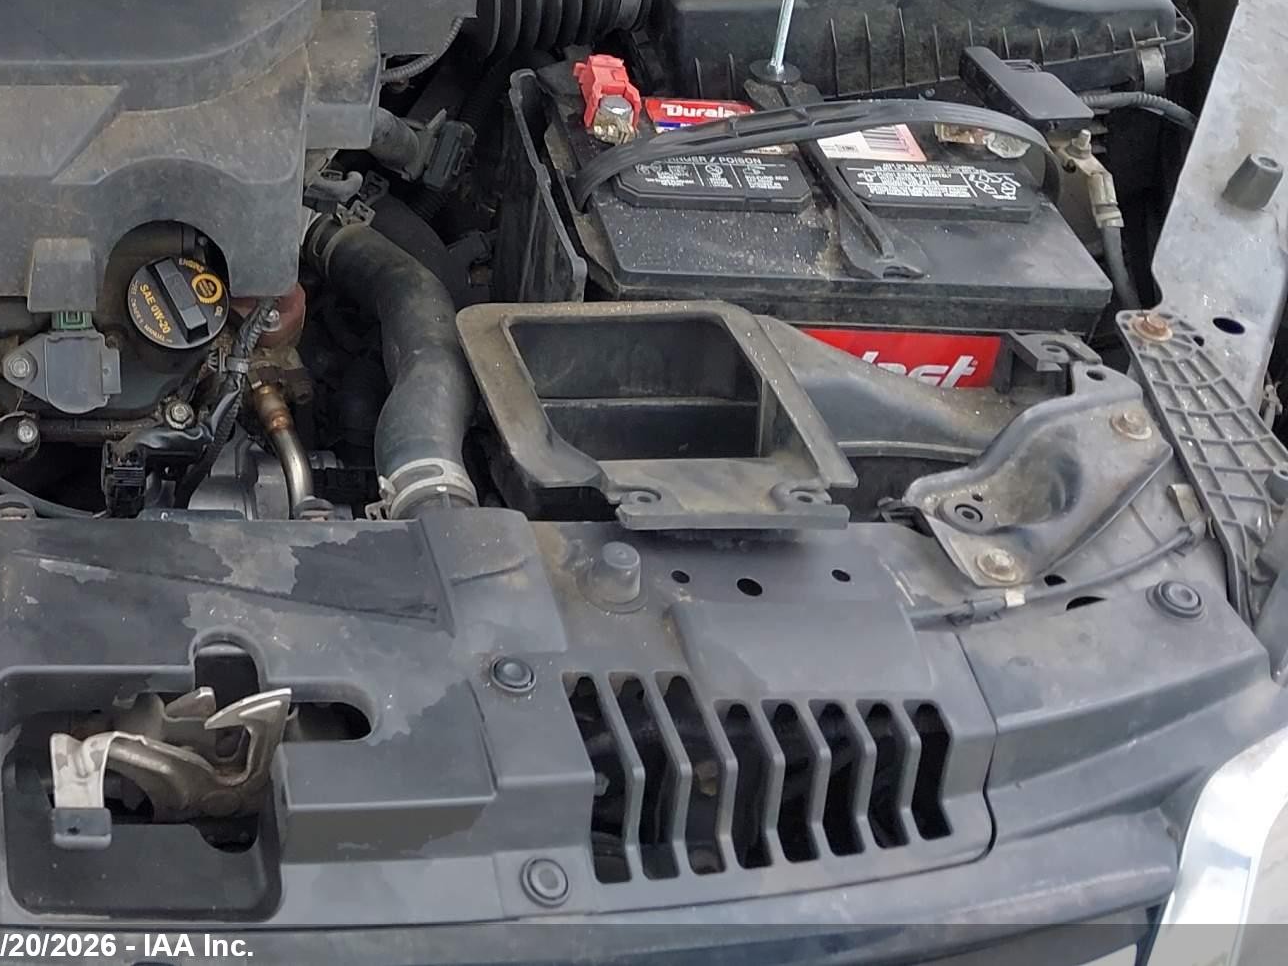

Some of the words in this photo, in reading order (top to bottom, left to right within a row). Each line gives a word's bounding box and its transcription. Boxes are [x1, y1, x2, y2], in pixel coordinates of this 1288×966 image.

[661, 103, 755, 119] Durala
[718, 156, 762, 165] POISON
[139, 283, 157, 305] SAE
[150, 305, 172, 334] 0W-20
